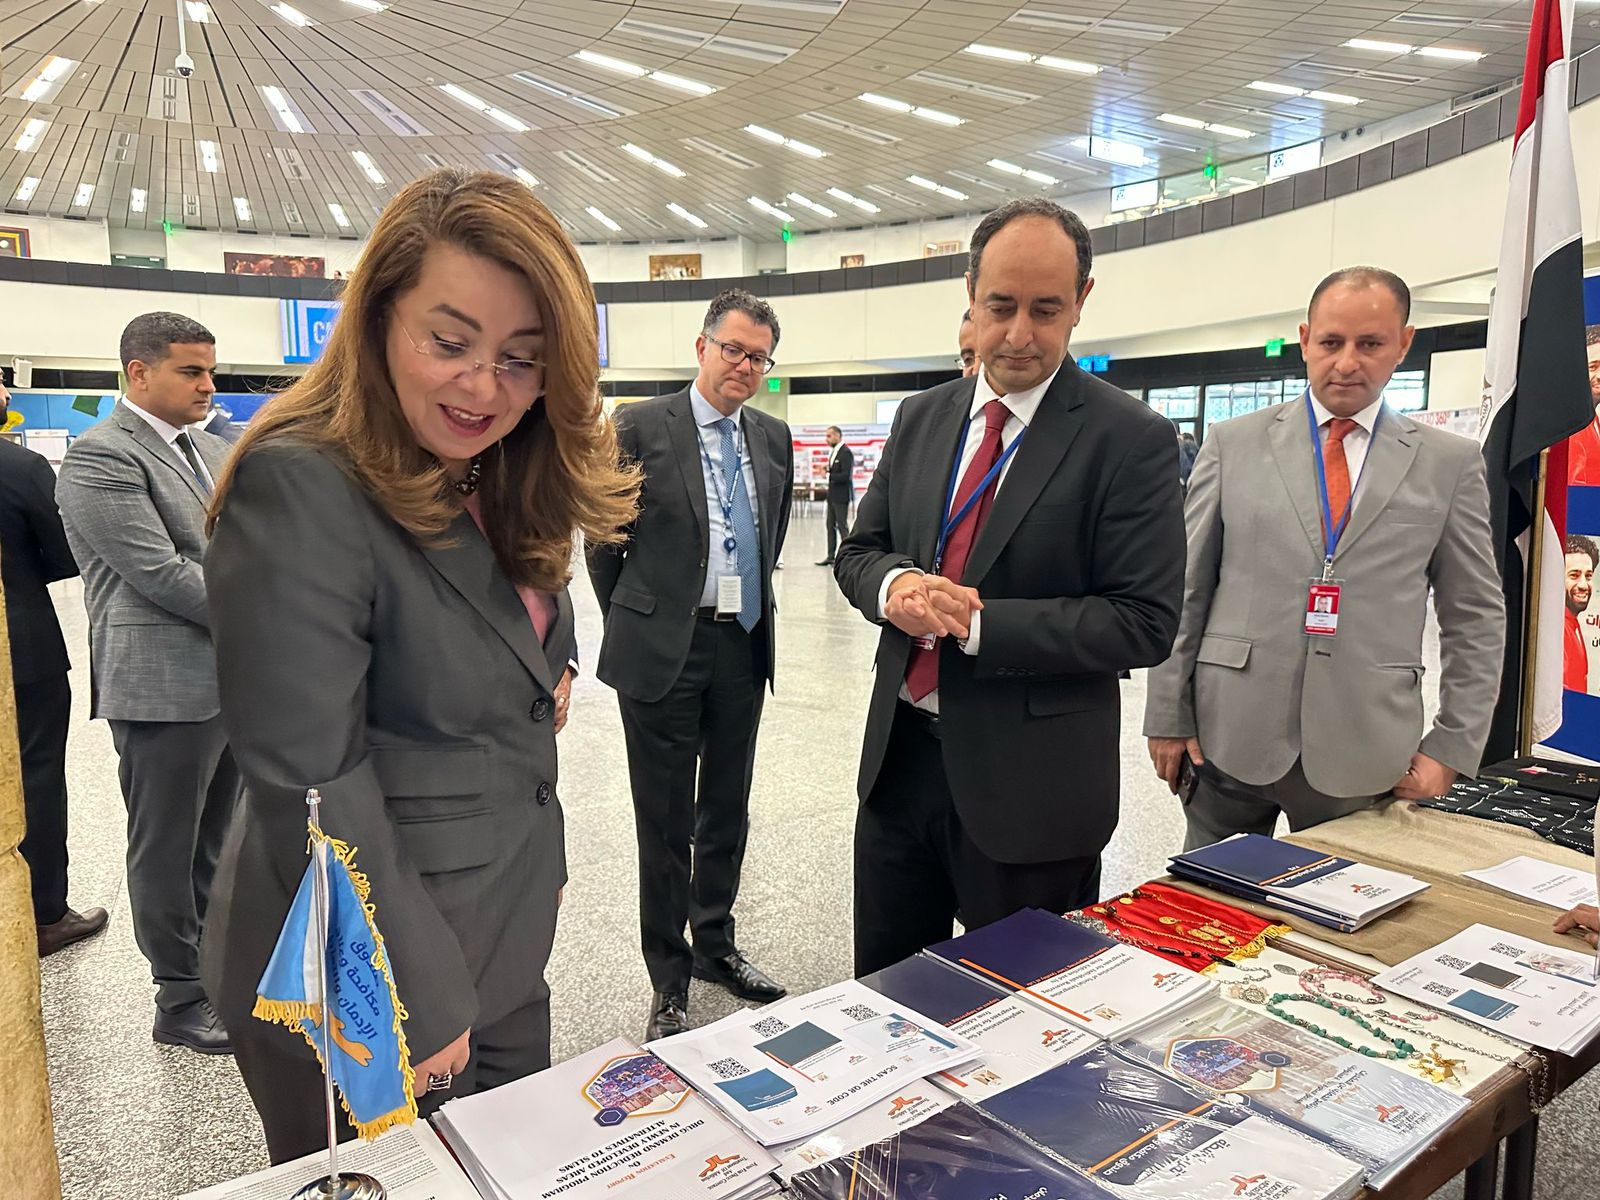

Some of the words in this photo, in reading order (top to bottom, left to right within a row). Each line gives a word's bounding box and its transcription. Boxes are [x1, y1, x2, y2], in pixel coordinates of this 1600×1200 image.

[347, 965, 381, 1017] مكافحة
[338, 997, 378, 1041] الإدمان
[875, 1064, 898, 1078] SCAN
[859, 1076, 878, 1087] THE
[847, 1085, 861, 1094] QR
[826, 1092, 849, 1106] CODE
[669, 1122, 680, 1130] IN
[679, 1119, 705, 1133] DRUG
[1137, 1121, 1159, 1134] ٢٠٢٤
[605, 1119, 665, 1150] ALTERNATIVES
[640, 1128, 670, 1144] NEWLY
[642, 1132, 679, 1152] DEMAND
[587, 1142, 640, 1169] DEVELOPED
[591, 1149, 604, 1158] TO
[1102, 1158, 1129, 1177] صندوق
[1124, 1142, 1160, 1161] مكافحة
[558, 1157, 590, 1172] SLUMS
[590, 1150, 642, 1178] REDUCTION
[726, 1156, 748, 1169] Treatment
[556, 1167, 586, 1182] AREAS
[541, 1175, 590, 1199] PROGRAM
